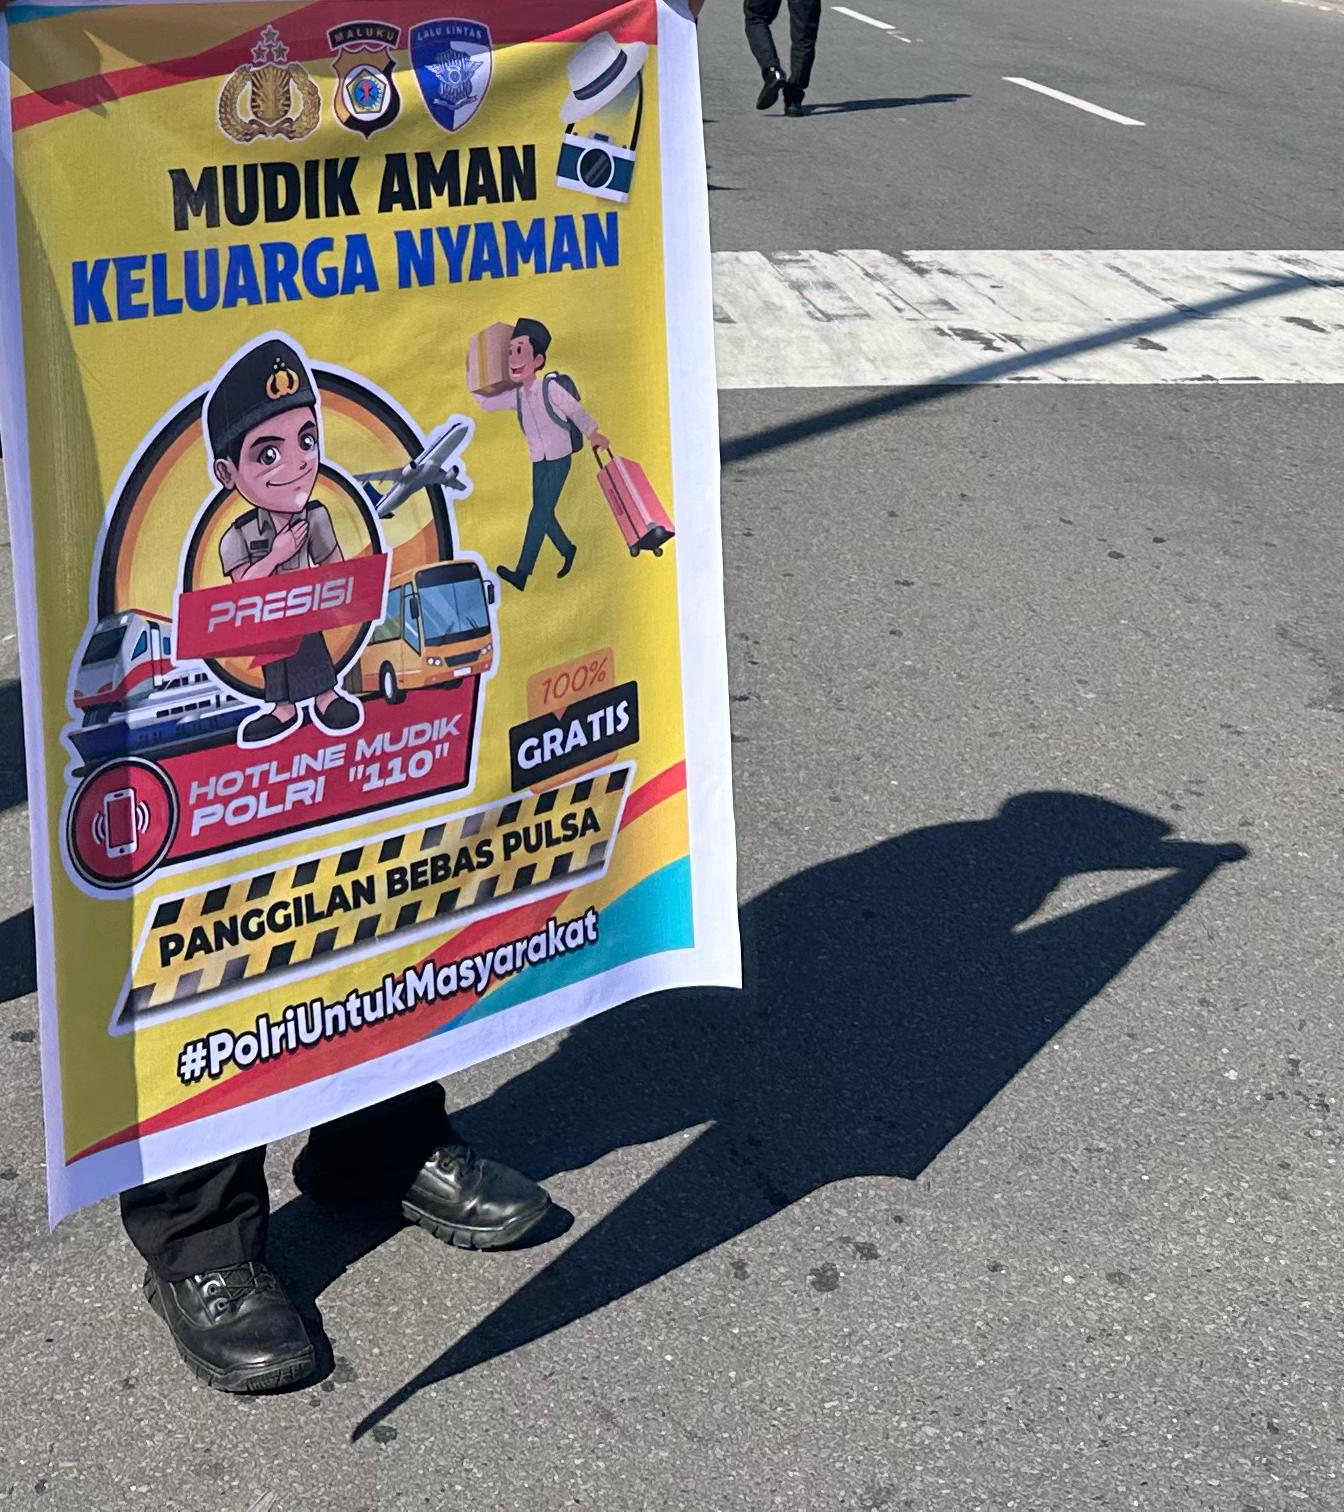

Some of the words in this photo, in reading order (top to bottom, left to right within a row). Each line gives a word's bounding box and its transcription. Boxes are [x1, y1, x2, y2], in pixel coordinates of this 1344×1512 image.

[334, 27, 395, 43] MALUKU
[417, 28, 442, 41] LALU
[446, 26, 482, 40] LINTAS
[169, 156, 360, 231] MUDIK
[378, 144, 537, 214] AMAN
[72, 233, 379, 326] KELUARGA
[396, 212, 620, 290] NYAMAN
[207, 577, 355, 633] PRESISI
[540, 658, 610, 704] 100%
[188, 742, 346, 805] HOTLINE
[355, 715, 461, 764] MUDIK
[516, 700, 630, 772] GRATIS
[190, 778, 325, 837] POLRI
[349, 742, 450, 795] "110"
[158, 875, 376, 968] PANGGILAN
[392, 838, 494, 897] BEBAS
[502, 809, 602, 861] PULSA
[178, 910, 599, 1085] #PolriUntukMasyarakat
